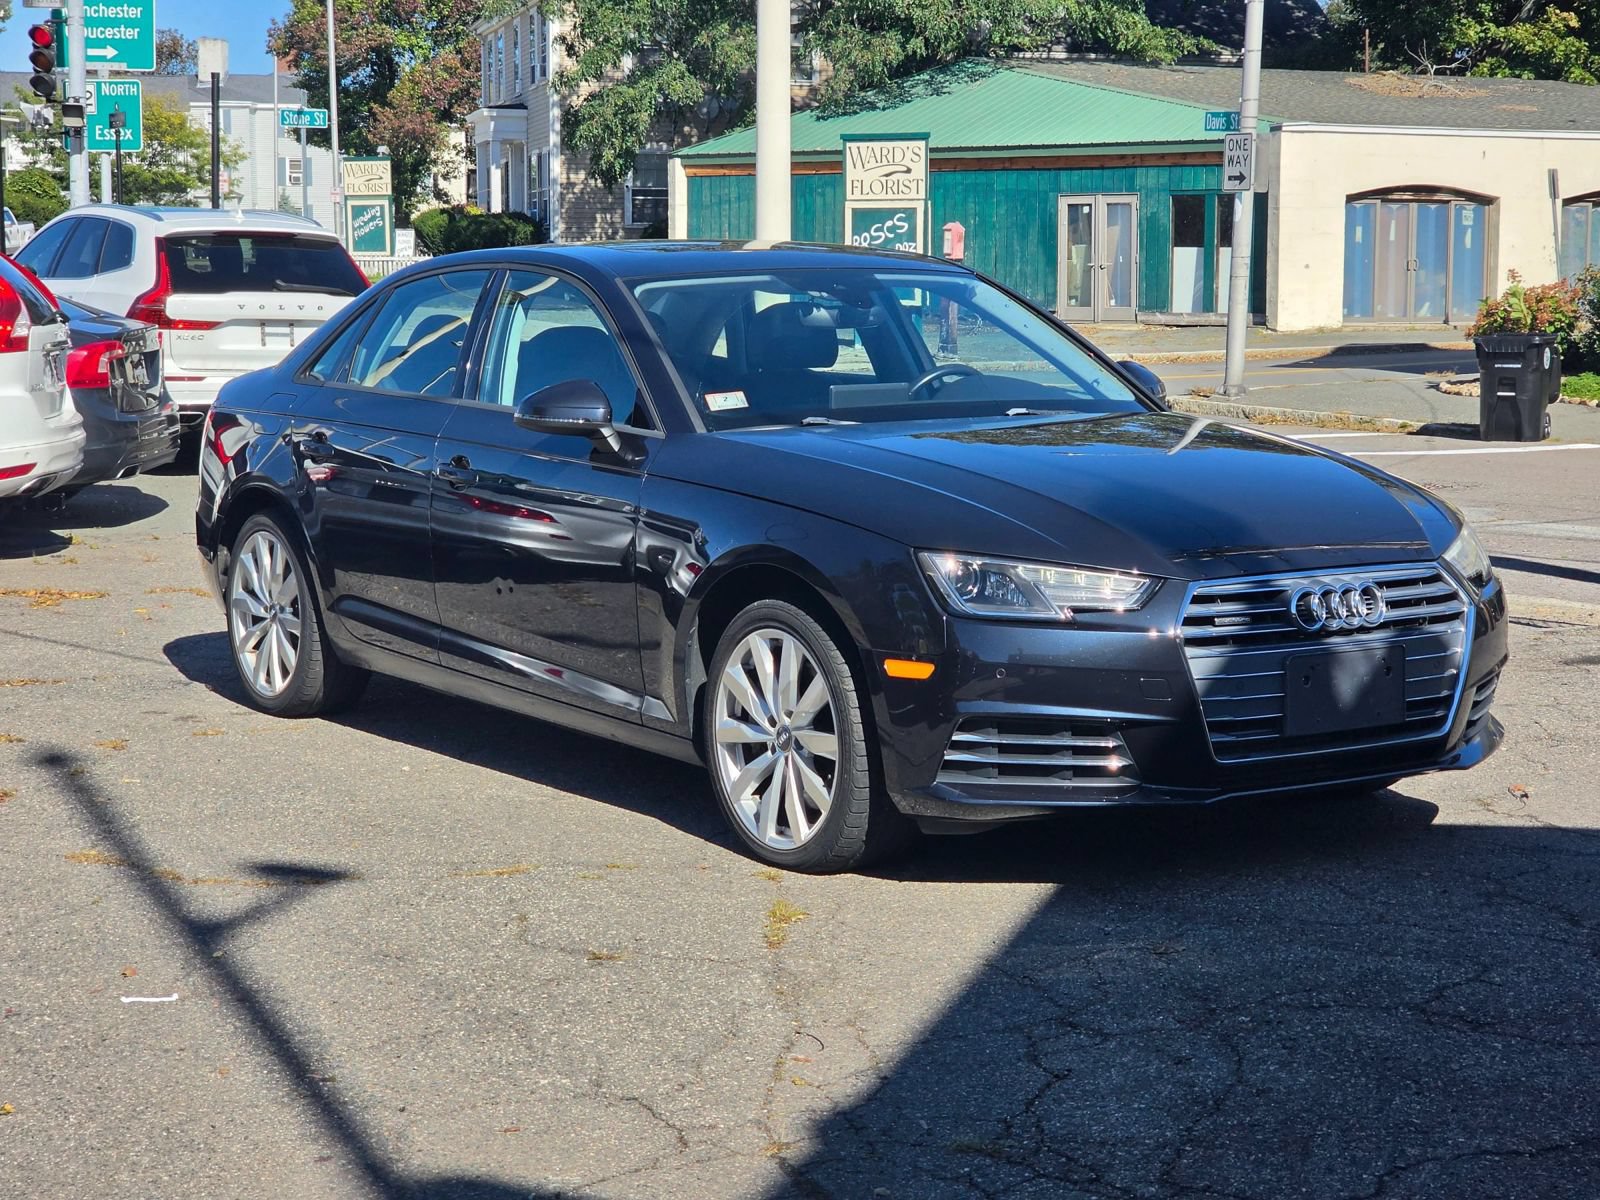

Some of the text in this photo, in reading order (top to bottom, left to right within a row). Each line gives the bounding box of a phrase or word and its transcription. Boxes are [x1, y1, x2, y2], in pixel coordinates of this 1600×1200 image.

[62, 3, 143, 18] nchester
[101, 83, 137, 96] NORTH
[283, 111, 324, 125] Stone St
[1206, 113, 1227, 129] Davis
[95, 125, 133, 140] Essex
[1228, 138, 1249, 152] ONE
[848, 145, 922, 169] WARD'S
[1227, 154, 1249, 167] WAY
[344, 162, 389, 178] WARD'S
[347, 182, 390, 193] FLORIST
[851, 178, 924, 196] FLORIST
[237, 304, 324, 312] VOLVO
